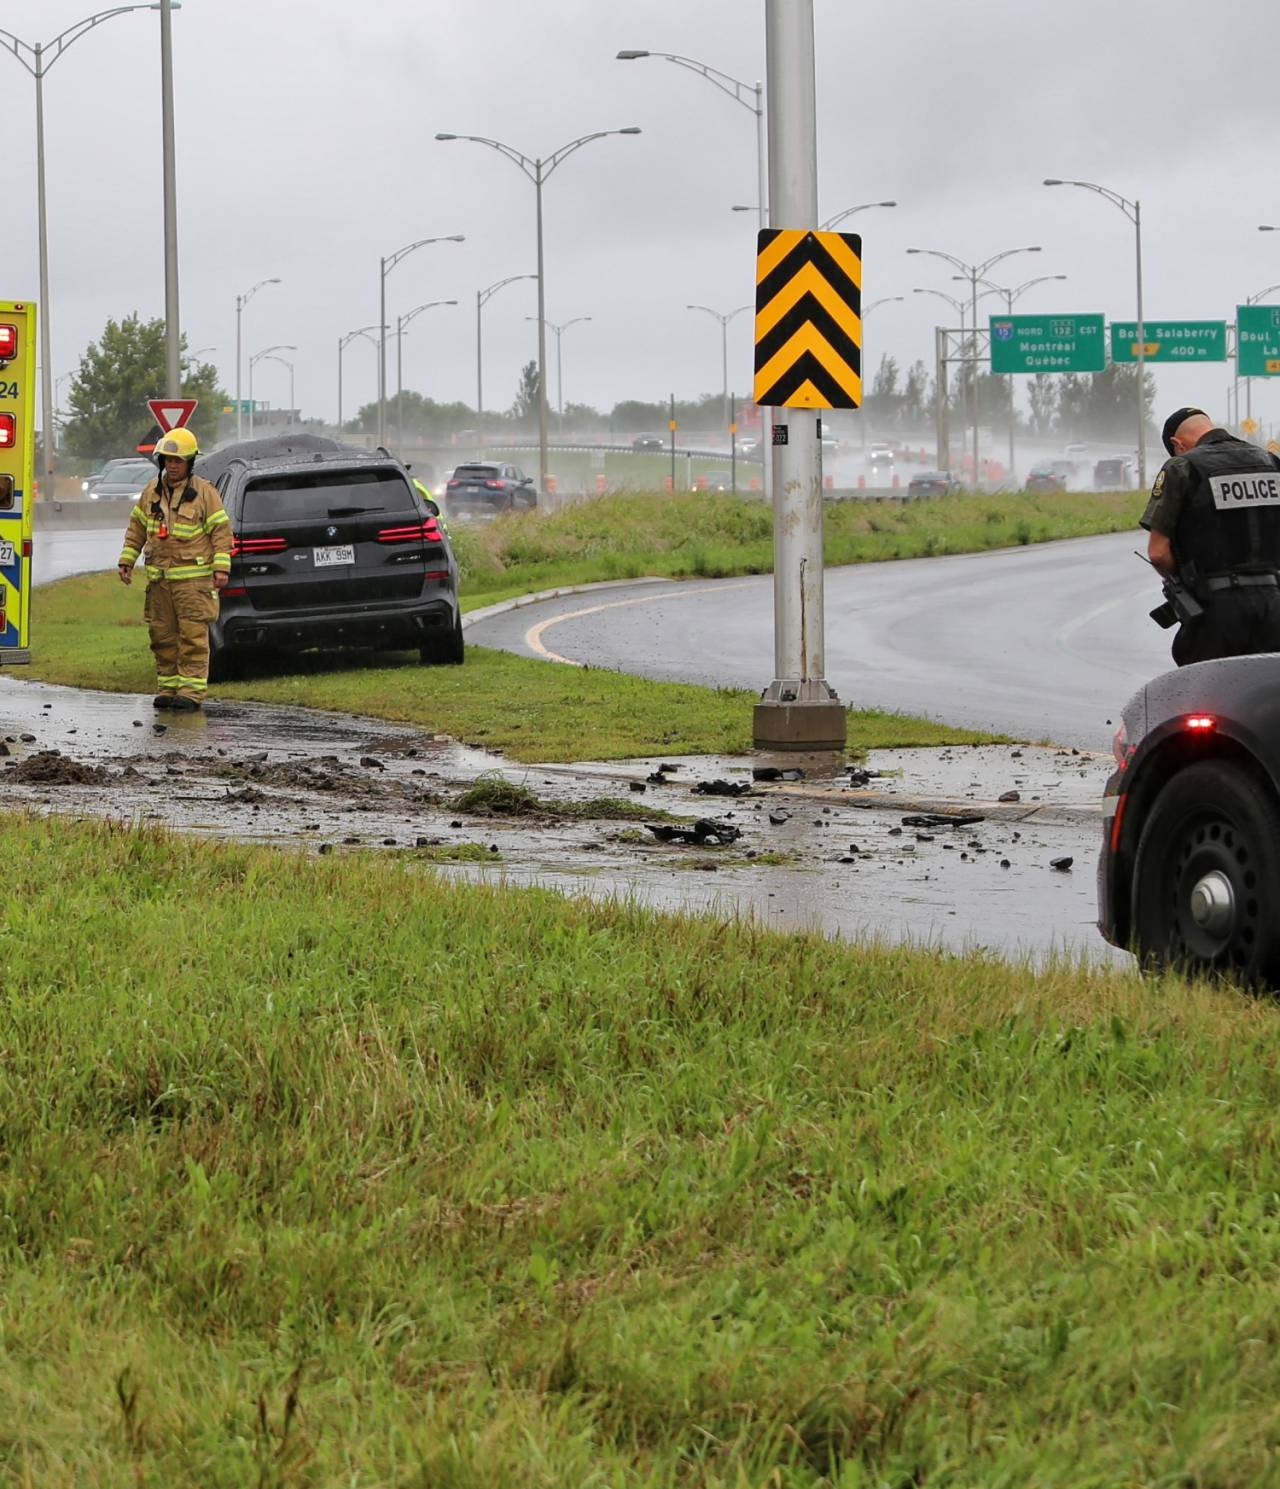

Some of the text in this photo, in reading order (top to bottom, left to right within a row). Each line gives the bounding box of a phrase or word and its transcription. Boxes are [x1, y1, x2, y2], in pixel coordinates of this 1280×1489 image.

[1018, 327, 1043, 336] NORD
[1054, 326, 1071, 336] 132
[1080, 326, 1097, 335] EST
[1156, 328, 1218, 340] Salaberry
[1020, 341, 1076, 352] Montréal
[1171, 346, 1195, 356] 400
[1025, 355, 1071, 366] Québec
[1220, 479, 1279, 501] POLICE
[315, 551, 331, 562] AKK
